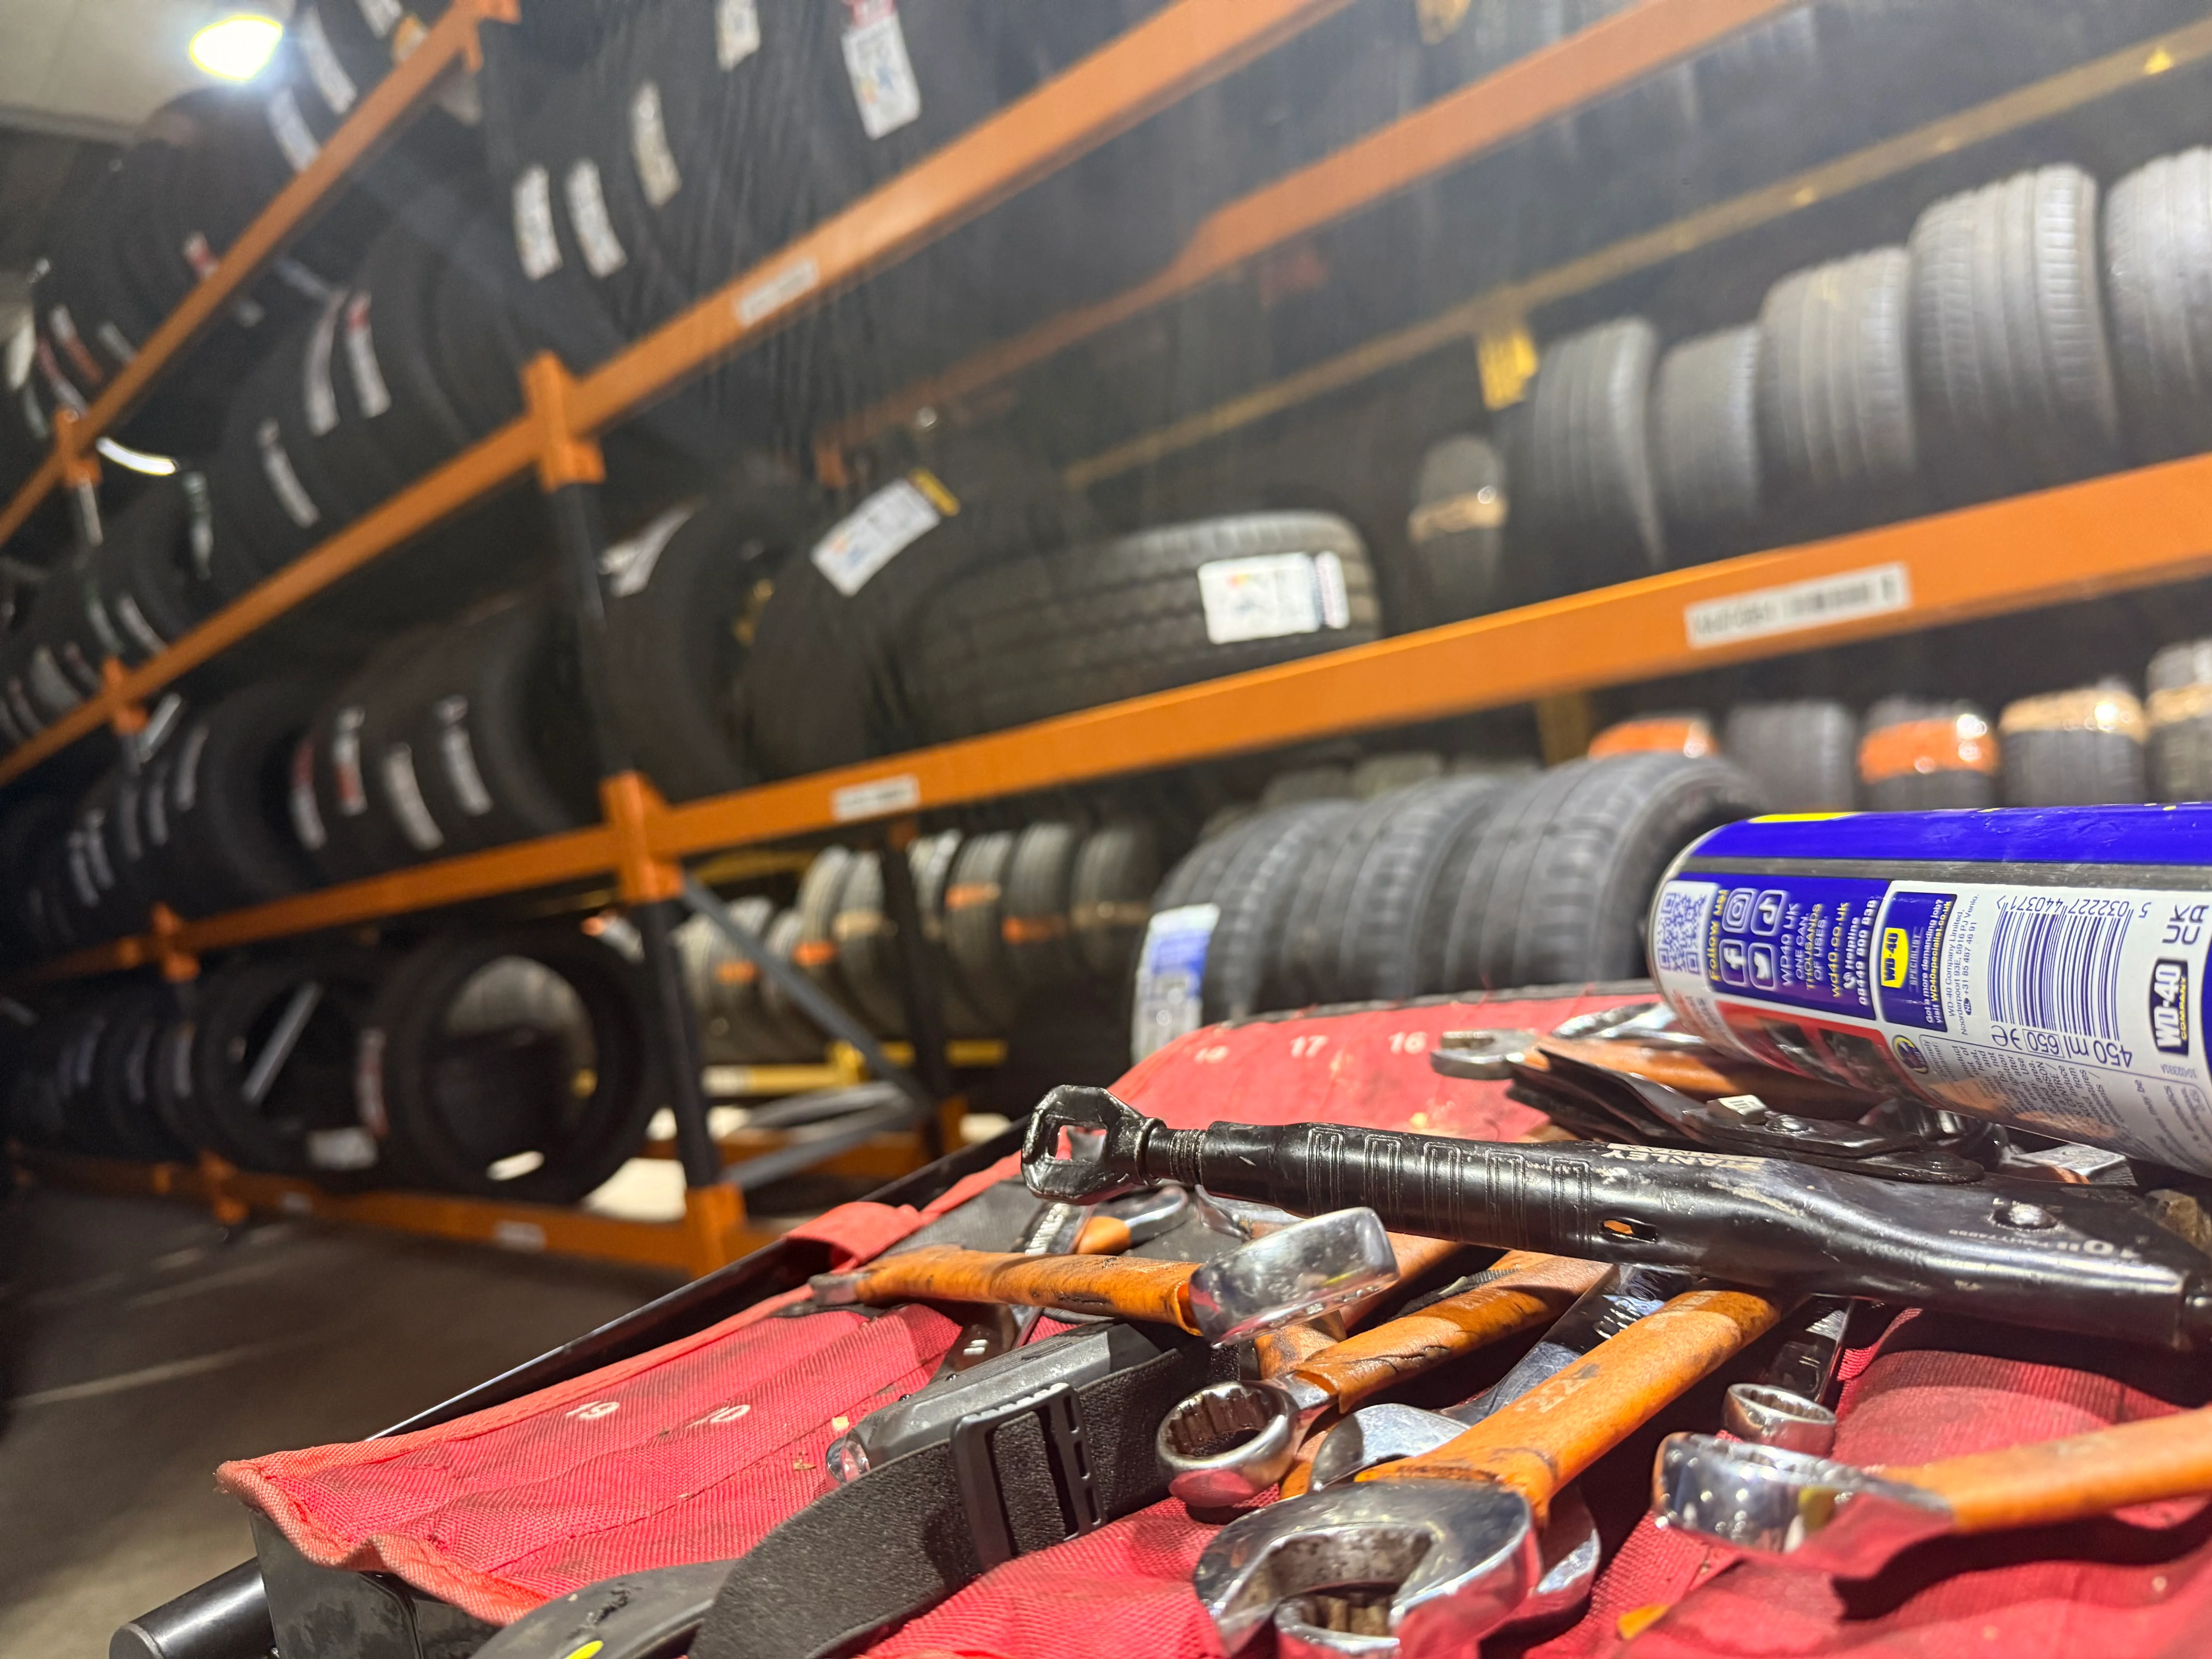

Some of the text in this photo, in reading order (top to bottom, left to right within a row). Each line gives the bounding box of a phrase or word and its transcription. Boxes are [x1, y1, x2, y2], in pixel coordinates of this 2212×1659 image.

[1930, 899, 1944, 919] job?
[2009, 895, 2152, 918] 5 032227 440371
[1969, 922, 1977, 932] 91
[2162, 904, 2191, 944] UK
[1707, 920, 1721, 982] Follow
[1780, 903, 1802, 986] WD40 UK
[1804, 904, 1824, 990] THOUSANDS
[1828, 902, 1851, 998] wd40.co.uk
[1845, 917, 1860, 970] Helpline
[1856, 929, 1870, 957] 800
[1921, 920, 1937, 971] demanding
[1967, 934, 1974, 944] 46
[1795, 949, 1806, 981] ONE
[1814, 960, 1824, 981] OF
[1910, 934, 1921, 986] SPECIALIST
[1930, 901, 1952, 1023] visit WD40specialist.co.uk
[1945, 910, 1965, 1017] WD-40 Company Limited,
[1954, 894, 1979, 1035] Noorderpoort 93E, 5916 PJ Venlo.
[1962, 965, 1969, 976] 85
[1856, 961, 1870, 1006] 08449
[1922, 973, 1930, 997] more
[1925, 1006, 1934, 1023] Got
[1965, 1001, 1971, 1012] NL
[2154, 963, 2183, 1047] WD-40
[2177, 976, 2187, 1041] COMPANY
[1290, 1035, 1329, 1058] 17
[1388, 1031, 1427, 1054] 16
[1959, 1046, 1969, 1056] of
[2026, 1031, 2060, 1056] 650
[2063, 1035, 2089, 1059] ml
[2093, 1040, 2133, 1068] 450
[1952, 1046, 1975, 1078] product
[1967, 1062, 1979, 1075] out
[1977, 1050, 1991, 1068] and
[1988, 1052, 1999, 1067] not
[1998, 1054, 2019, 1086] ignition
[2007, 1055, 2021, 1077] after
[2018, 1058, 2029, 1075] Use
[1997, 1071, 2008, 1082] Do
[2029, 1060, 2043, 1084] area.
[2035, 1061, 2060, 1097] POISON
[2058, 1065, 2078, 1096] induce
[2069, 1068, 2083, 1089] from
[2050, 1073, 2076, 1107] CENTRE
[2134, 1080, 2145, 1093] be
[565, 1400, 620, 1420] 19
